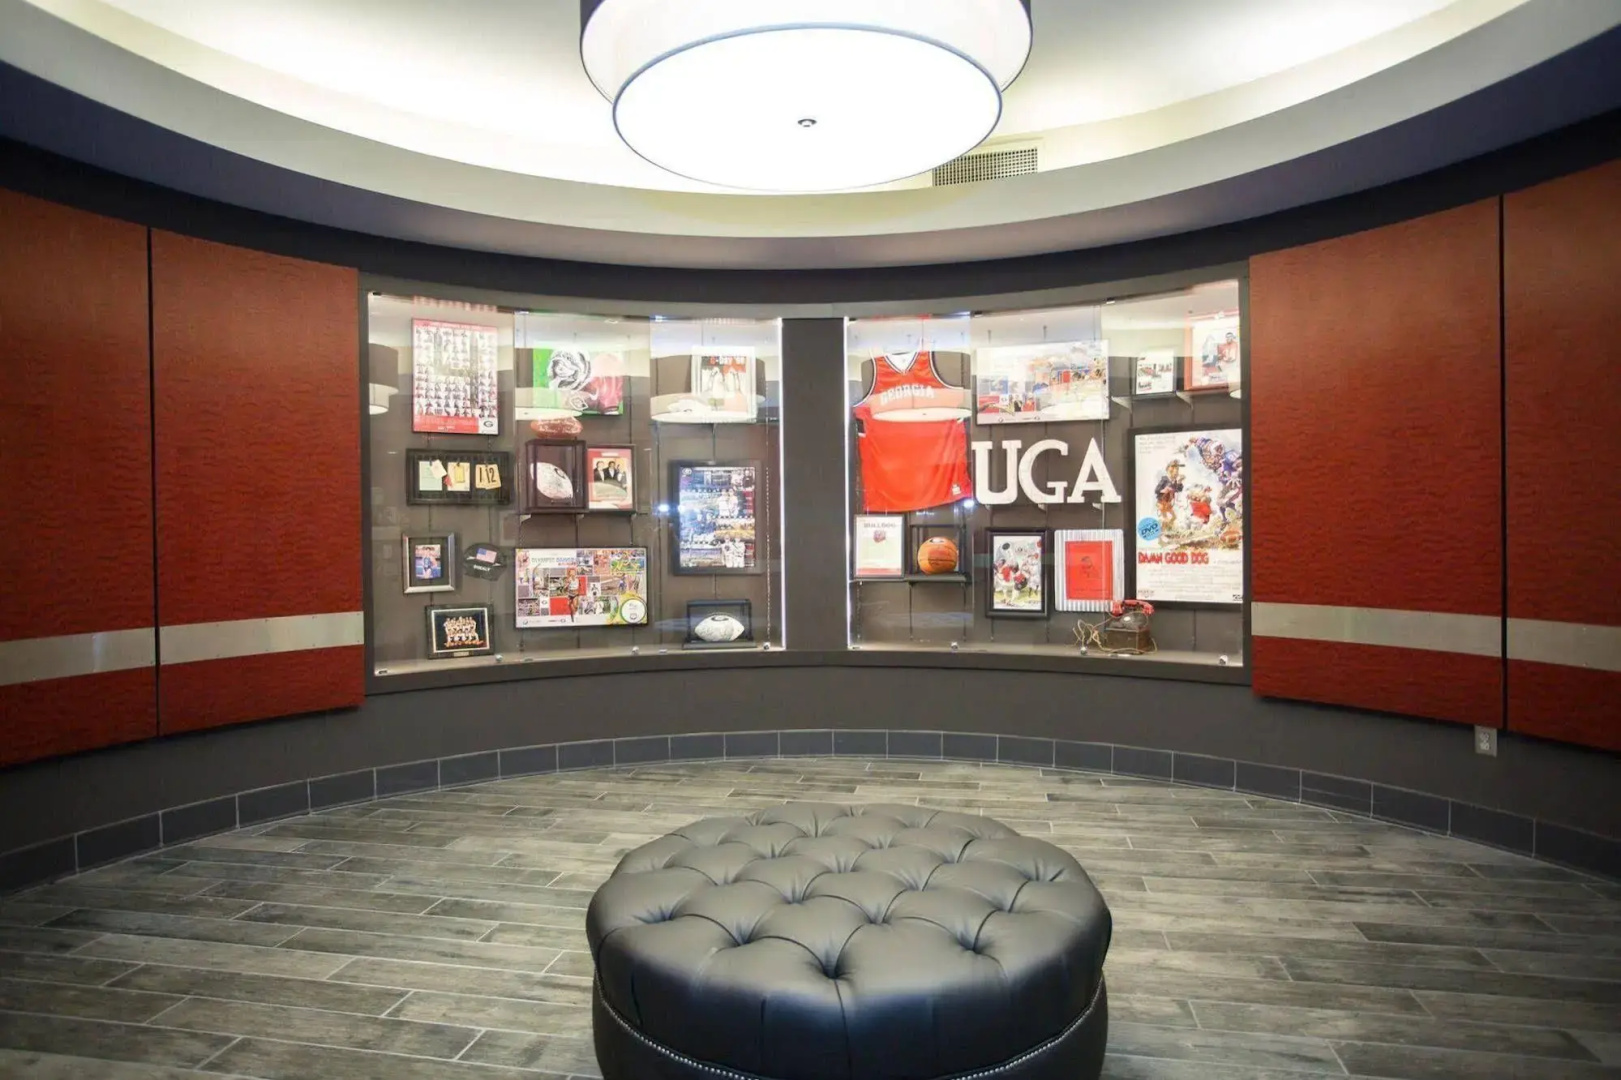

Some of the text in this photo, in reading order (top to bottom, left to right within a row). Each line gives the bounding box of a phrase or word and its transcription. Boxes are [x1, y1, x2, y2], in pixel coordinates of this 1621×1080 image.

[880, 383, 935, 405] GEORGIA
[971, 437, 1122, 505] UGA
[1141, 523, 1159, 536] DVD
[1165, 551, 1188, 564] GOOD
[1191, 551, 1209, 564] DOG
